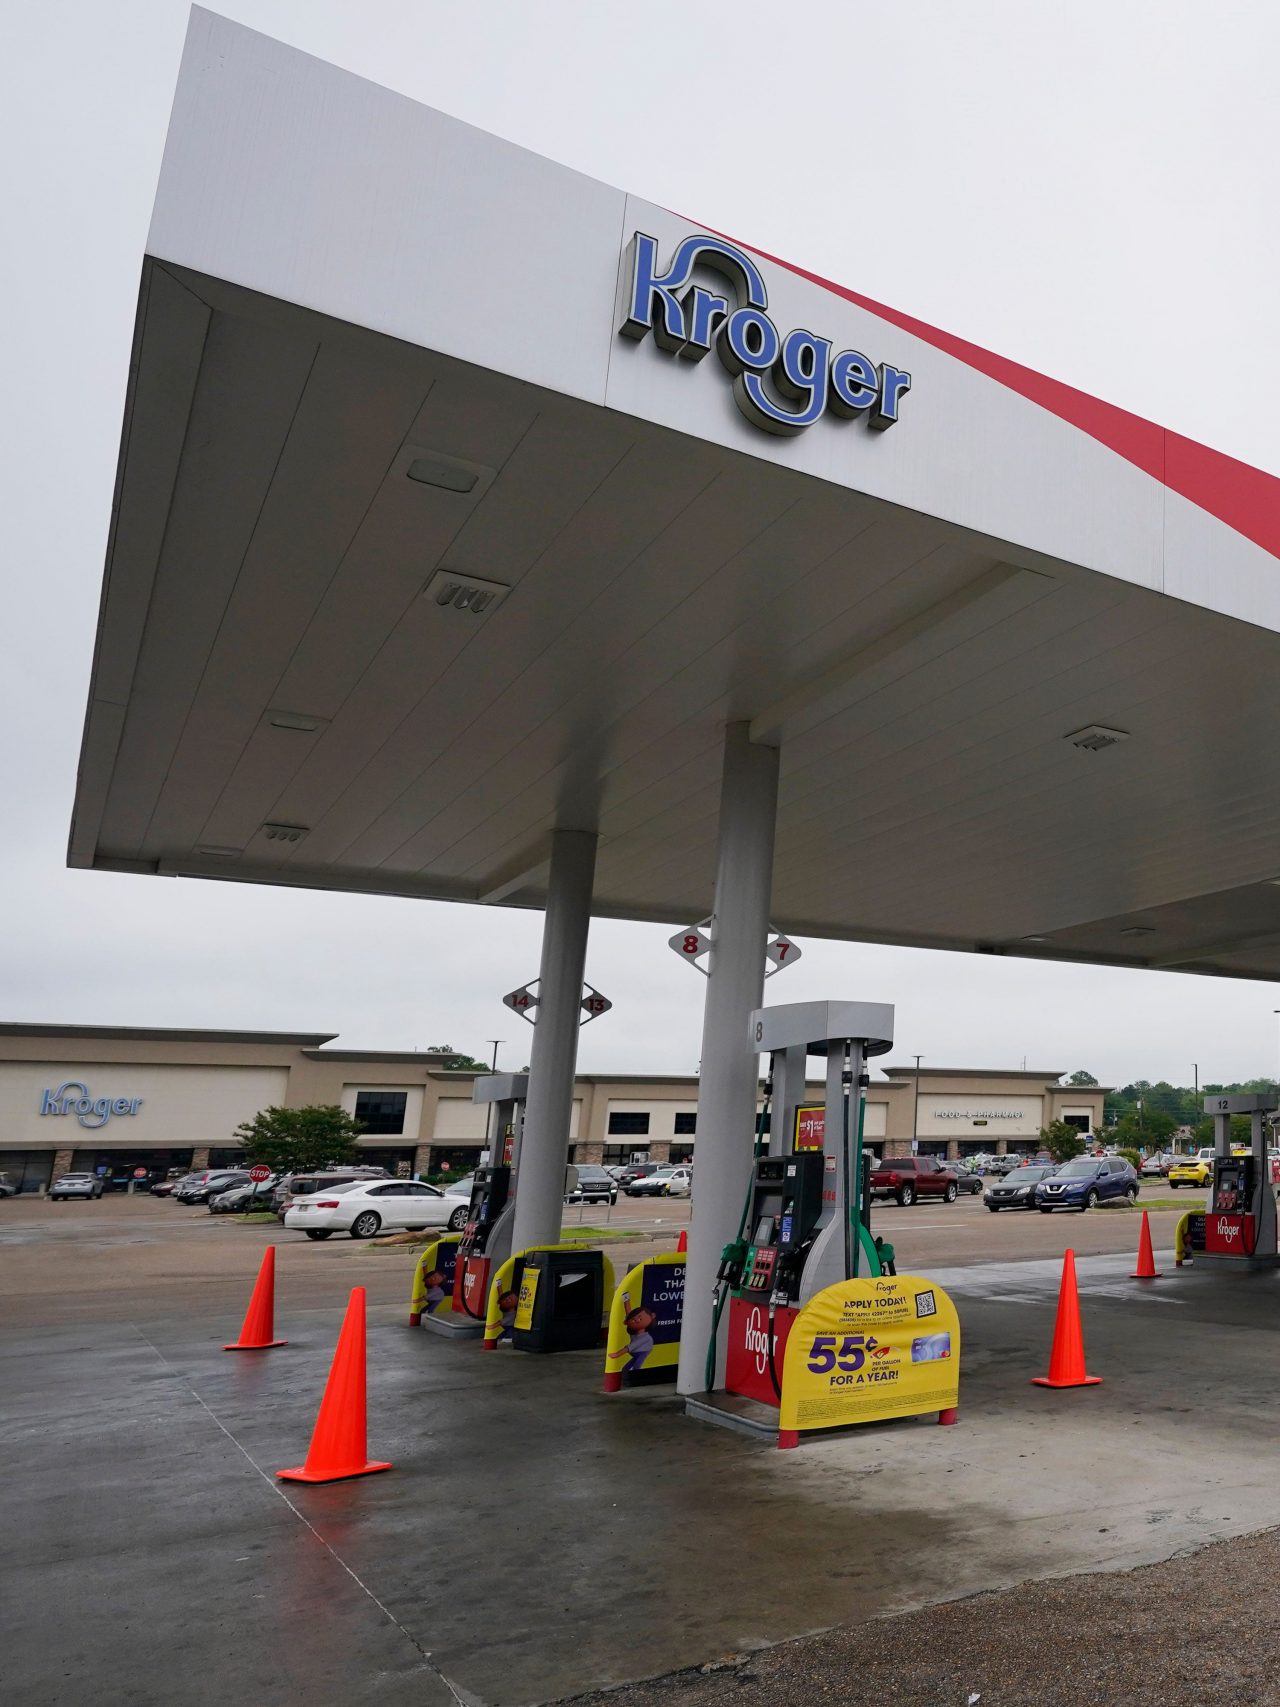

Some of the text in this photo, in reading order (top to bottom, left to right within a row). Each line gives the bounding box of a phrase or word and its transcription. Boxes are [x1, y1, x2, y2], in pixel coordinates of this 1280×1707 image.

[622, 231, 911, 432] Kroger
[682, 935, 698, 953] 8
[776, 943, 789, 960] 7
[512, 995, 529, 1007] 14
[588, 999, 604, 1012] 13
[756, 1021, 763, 1042] 8
[40, 1081, 143, 1128] Kroger
[1218, 1100, 1228, 1109] 12
[250, 1169, 270, 1178] STOP
[1217, 1216, 1239, 1243] Kroger
[844, 1296, 907, 1309] APPLY TODAY!
[830, 1370, 899, 1386] FOR A YEAR!
